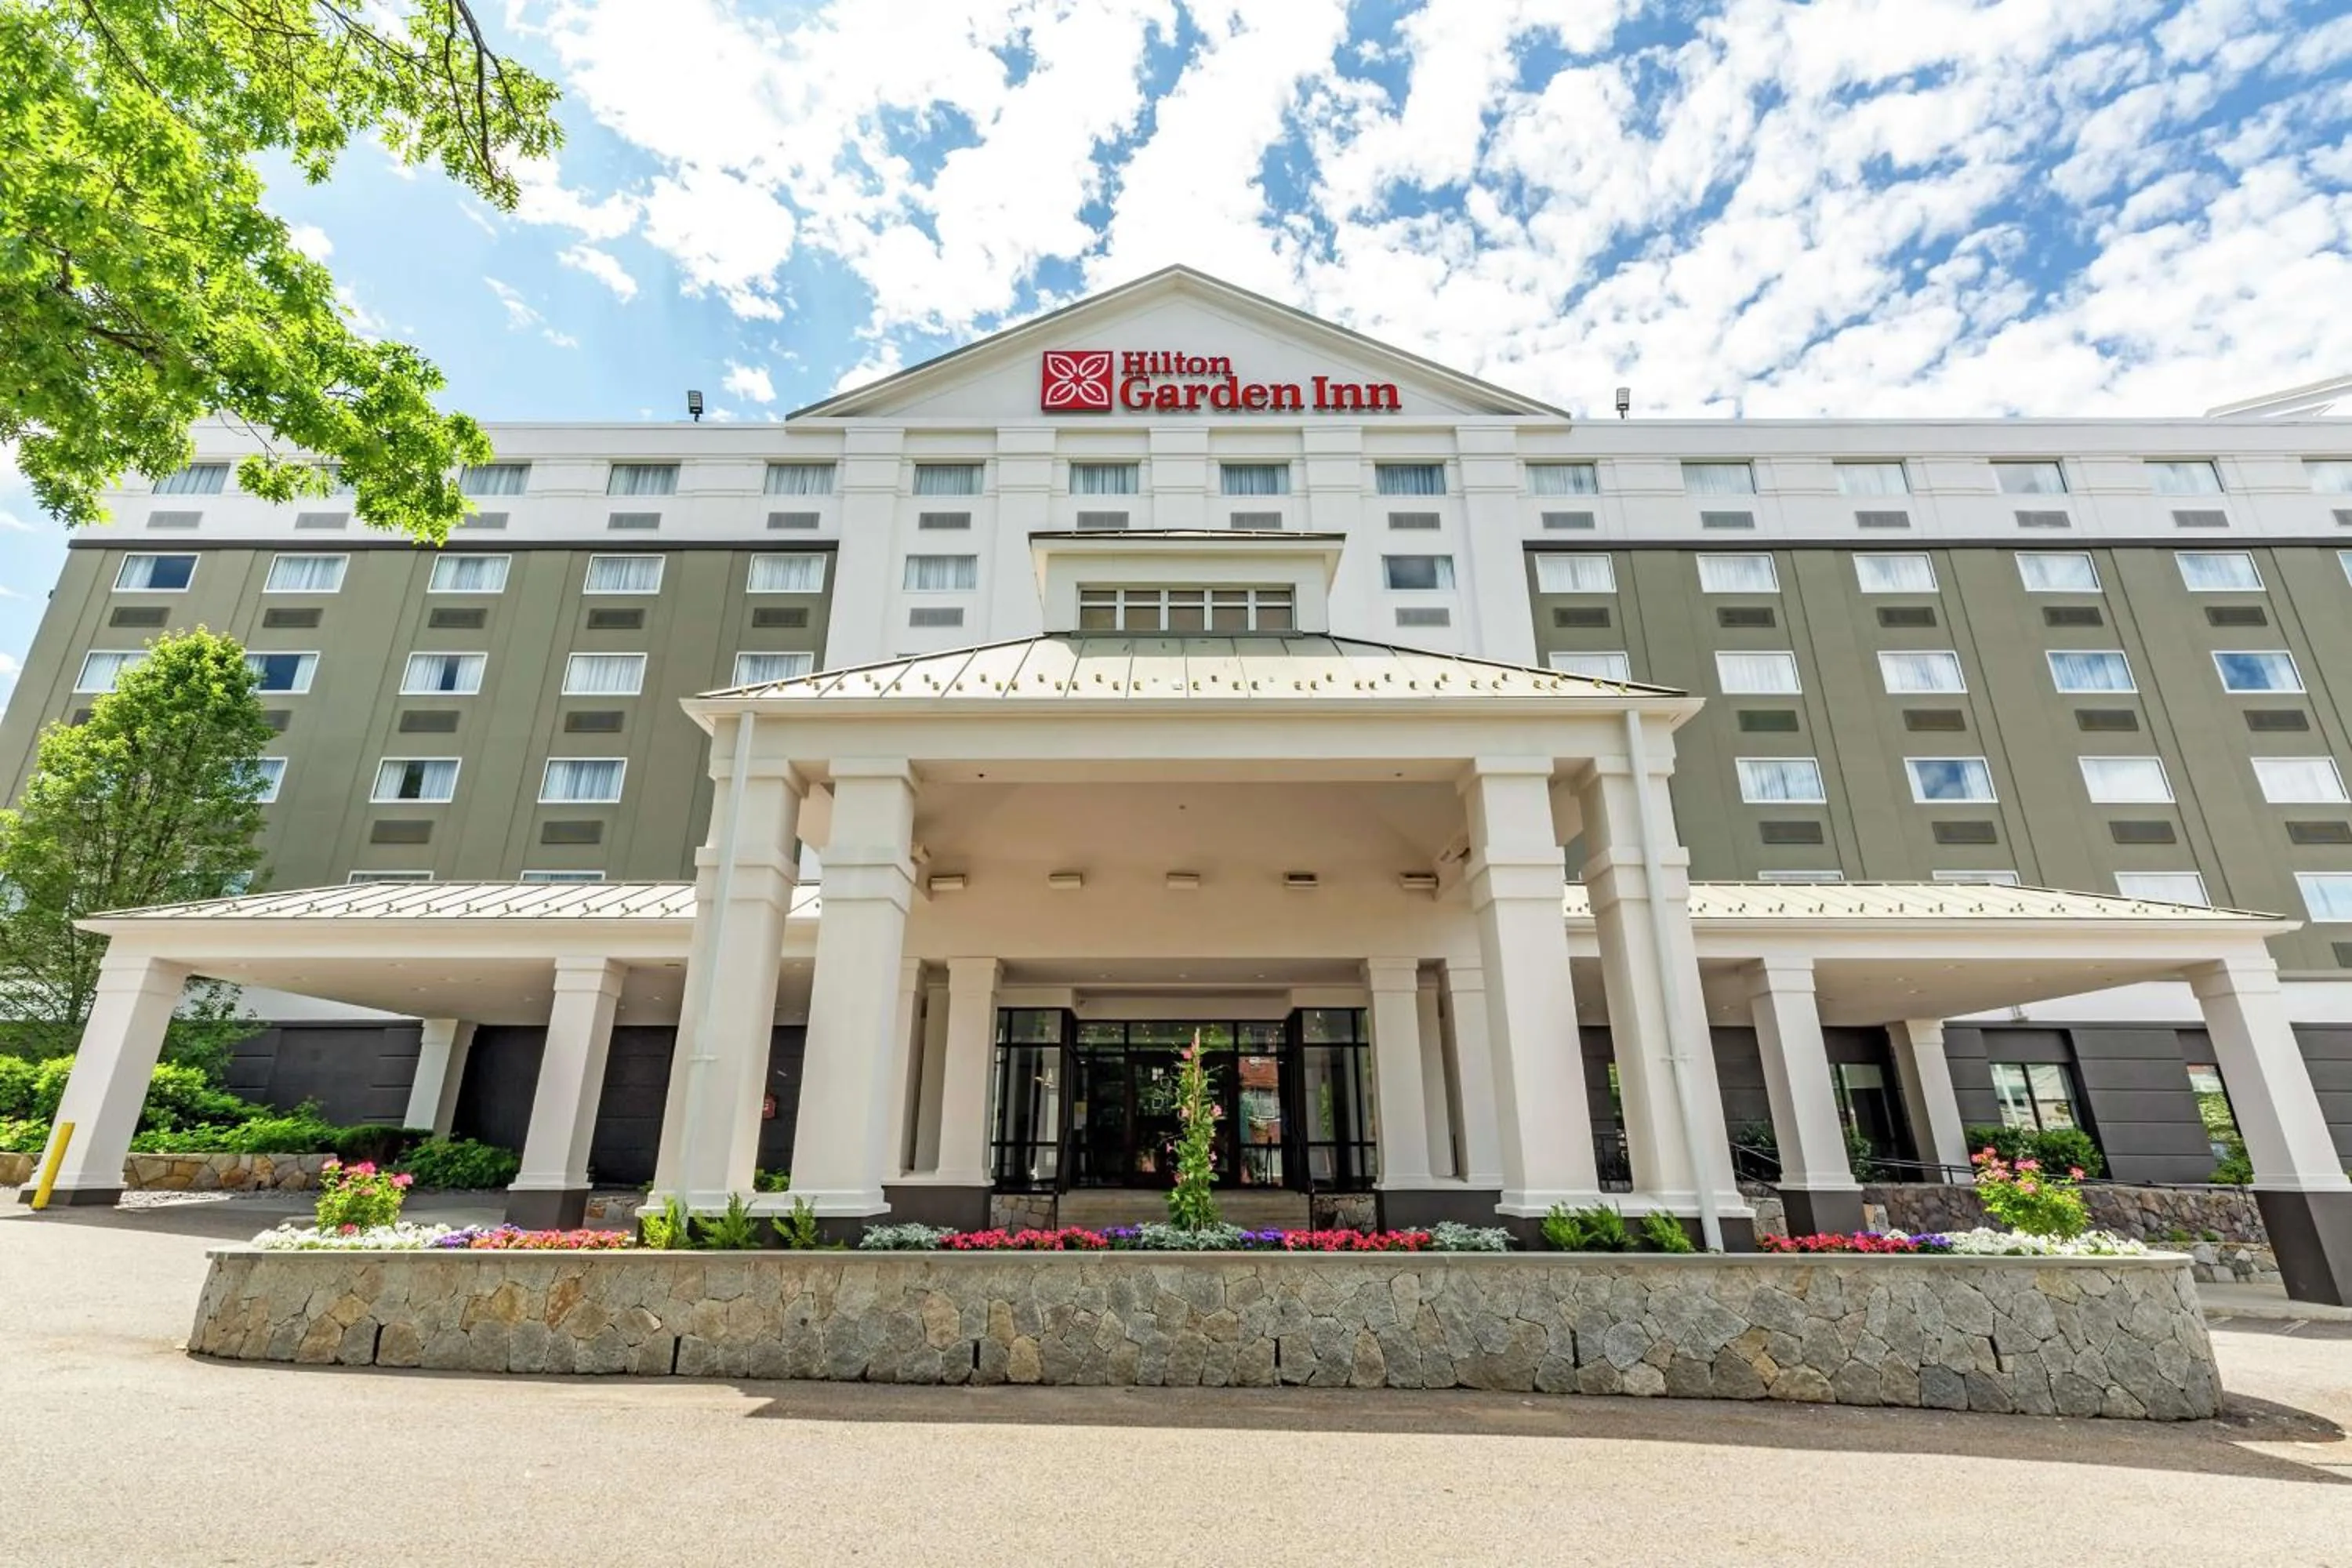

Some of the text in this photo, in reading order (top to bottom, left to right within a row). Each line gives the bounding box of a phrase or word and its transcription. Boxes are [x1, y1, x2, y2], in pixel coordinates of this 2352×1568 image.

[1121, 351, 1232, 376] Hilton
[1120, 376, 1402, 411] Garden Inn
